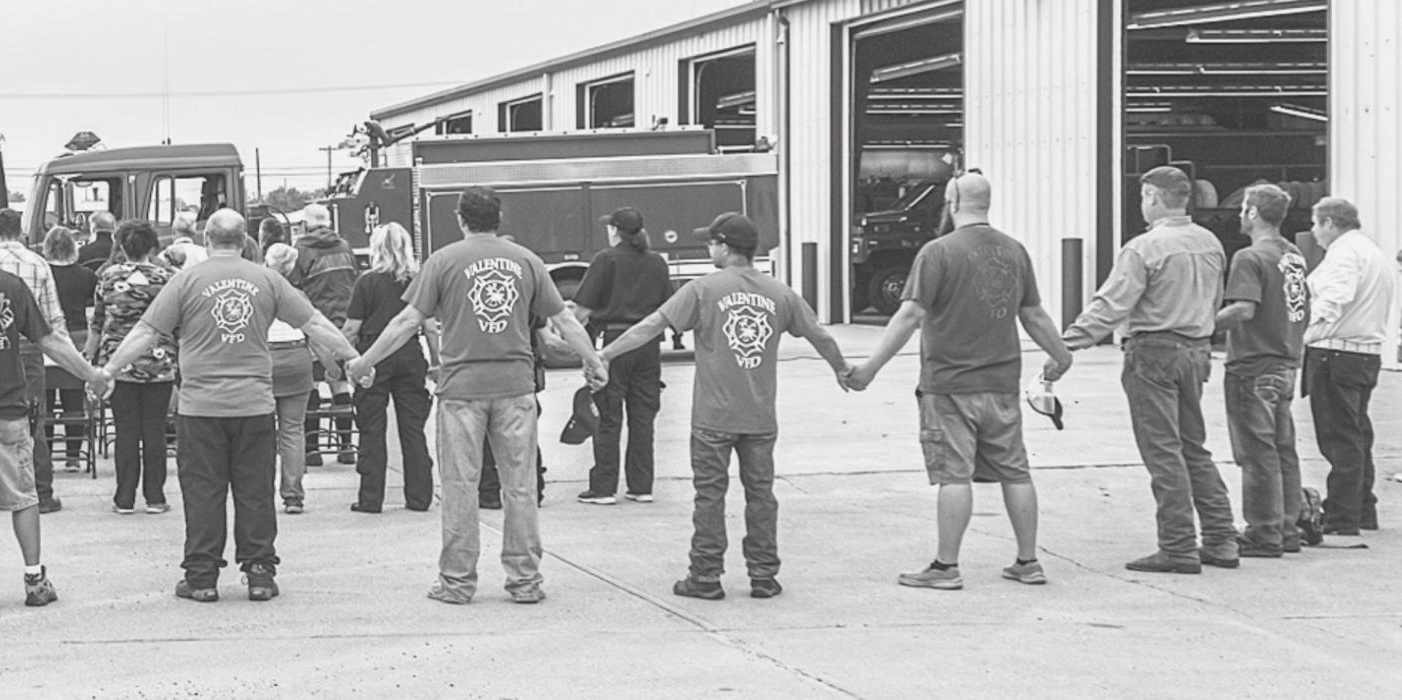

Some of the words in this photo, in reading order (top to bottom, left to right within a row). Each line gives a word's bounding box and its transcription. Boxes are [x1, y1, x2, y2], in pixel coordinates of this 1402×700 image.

[463, 257, 523, 279] VALENTINE
[201, 278, 259, 297] VALENTINE
[717, 291, 776, 315] VALENTINE
[478, 319, 508, 333] VFD
[221, 333, 245, 343] VFD
[735, 353, 762, 369] VFD
